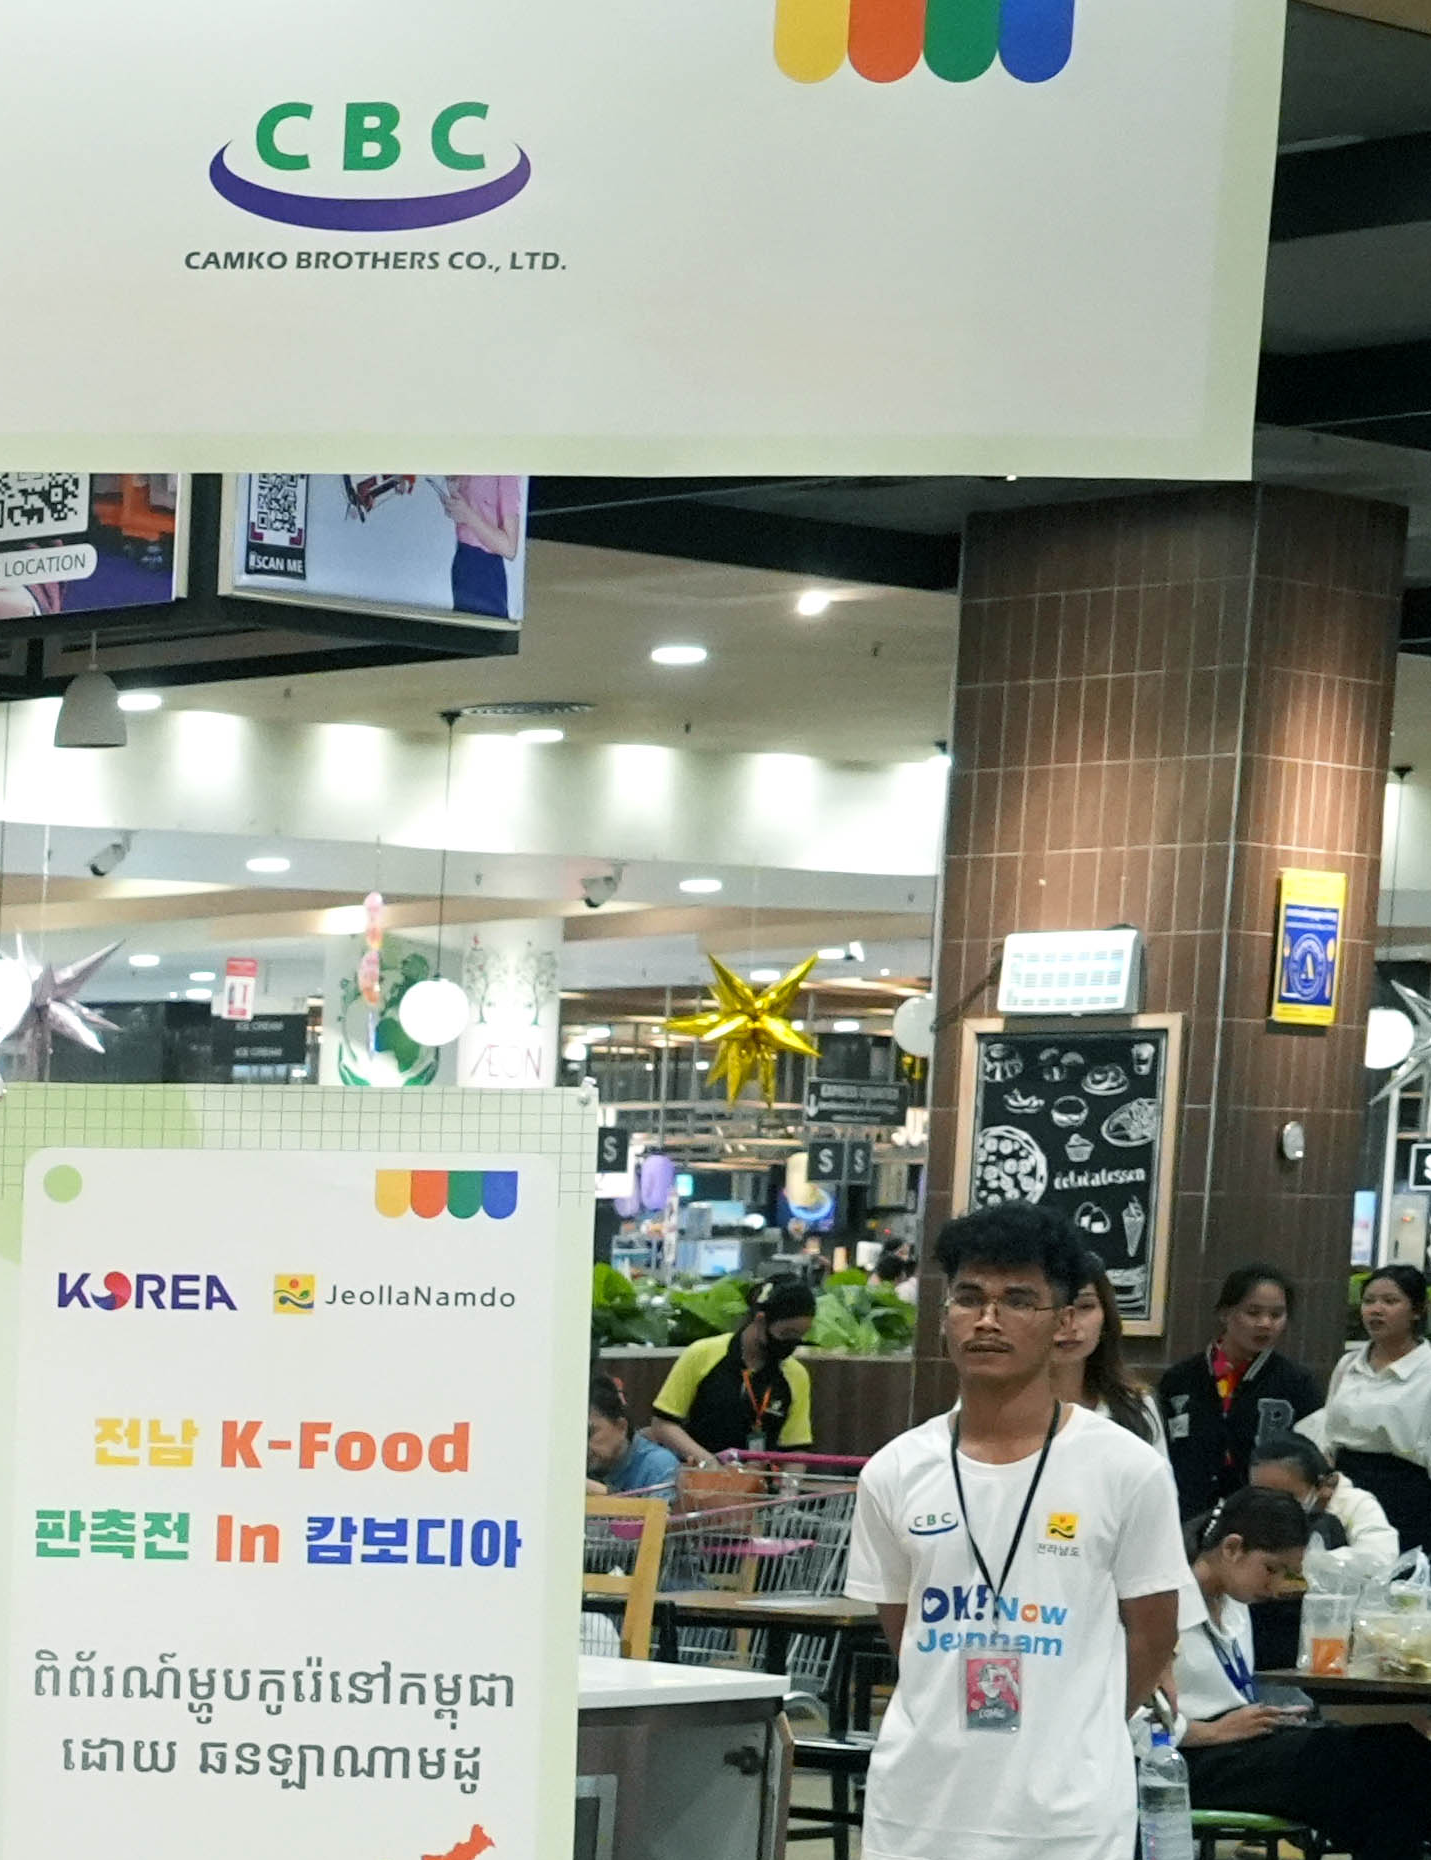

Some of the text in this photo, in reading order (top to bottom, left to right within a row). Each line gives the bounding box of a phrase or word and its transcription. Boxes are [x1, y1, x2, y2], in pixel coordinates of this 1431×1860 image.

[184, 249, 567, 274] CAMKO BROTHERS CO., LTD.
[4, 552, 86, 578] LOCATION
[256, 555, 304, 574] SCAN ME
[56, 1270, 238, 1311] KOREA
[325, 1283, 516, 1308] JeollaNamdo
[94, 1417, 471, 1473] 전남 K-Food
[35, 1507, 523, 1569] 판촉전 In 캄보디아
[921, 1583, 1068, 1626] OK! Now
